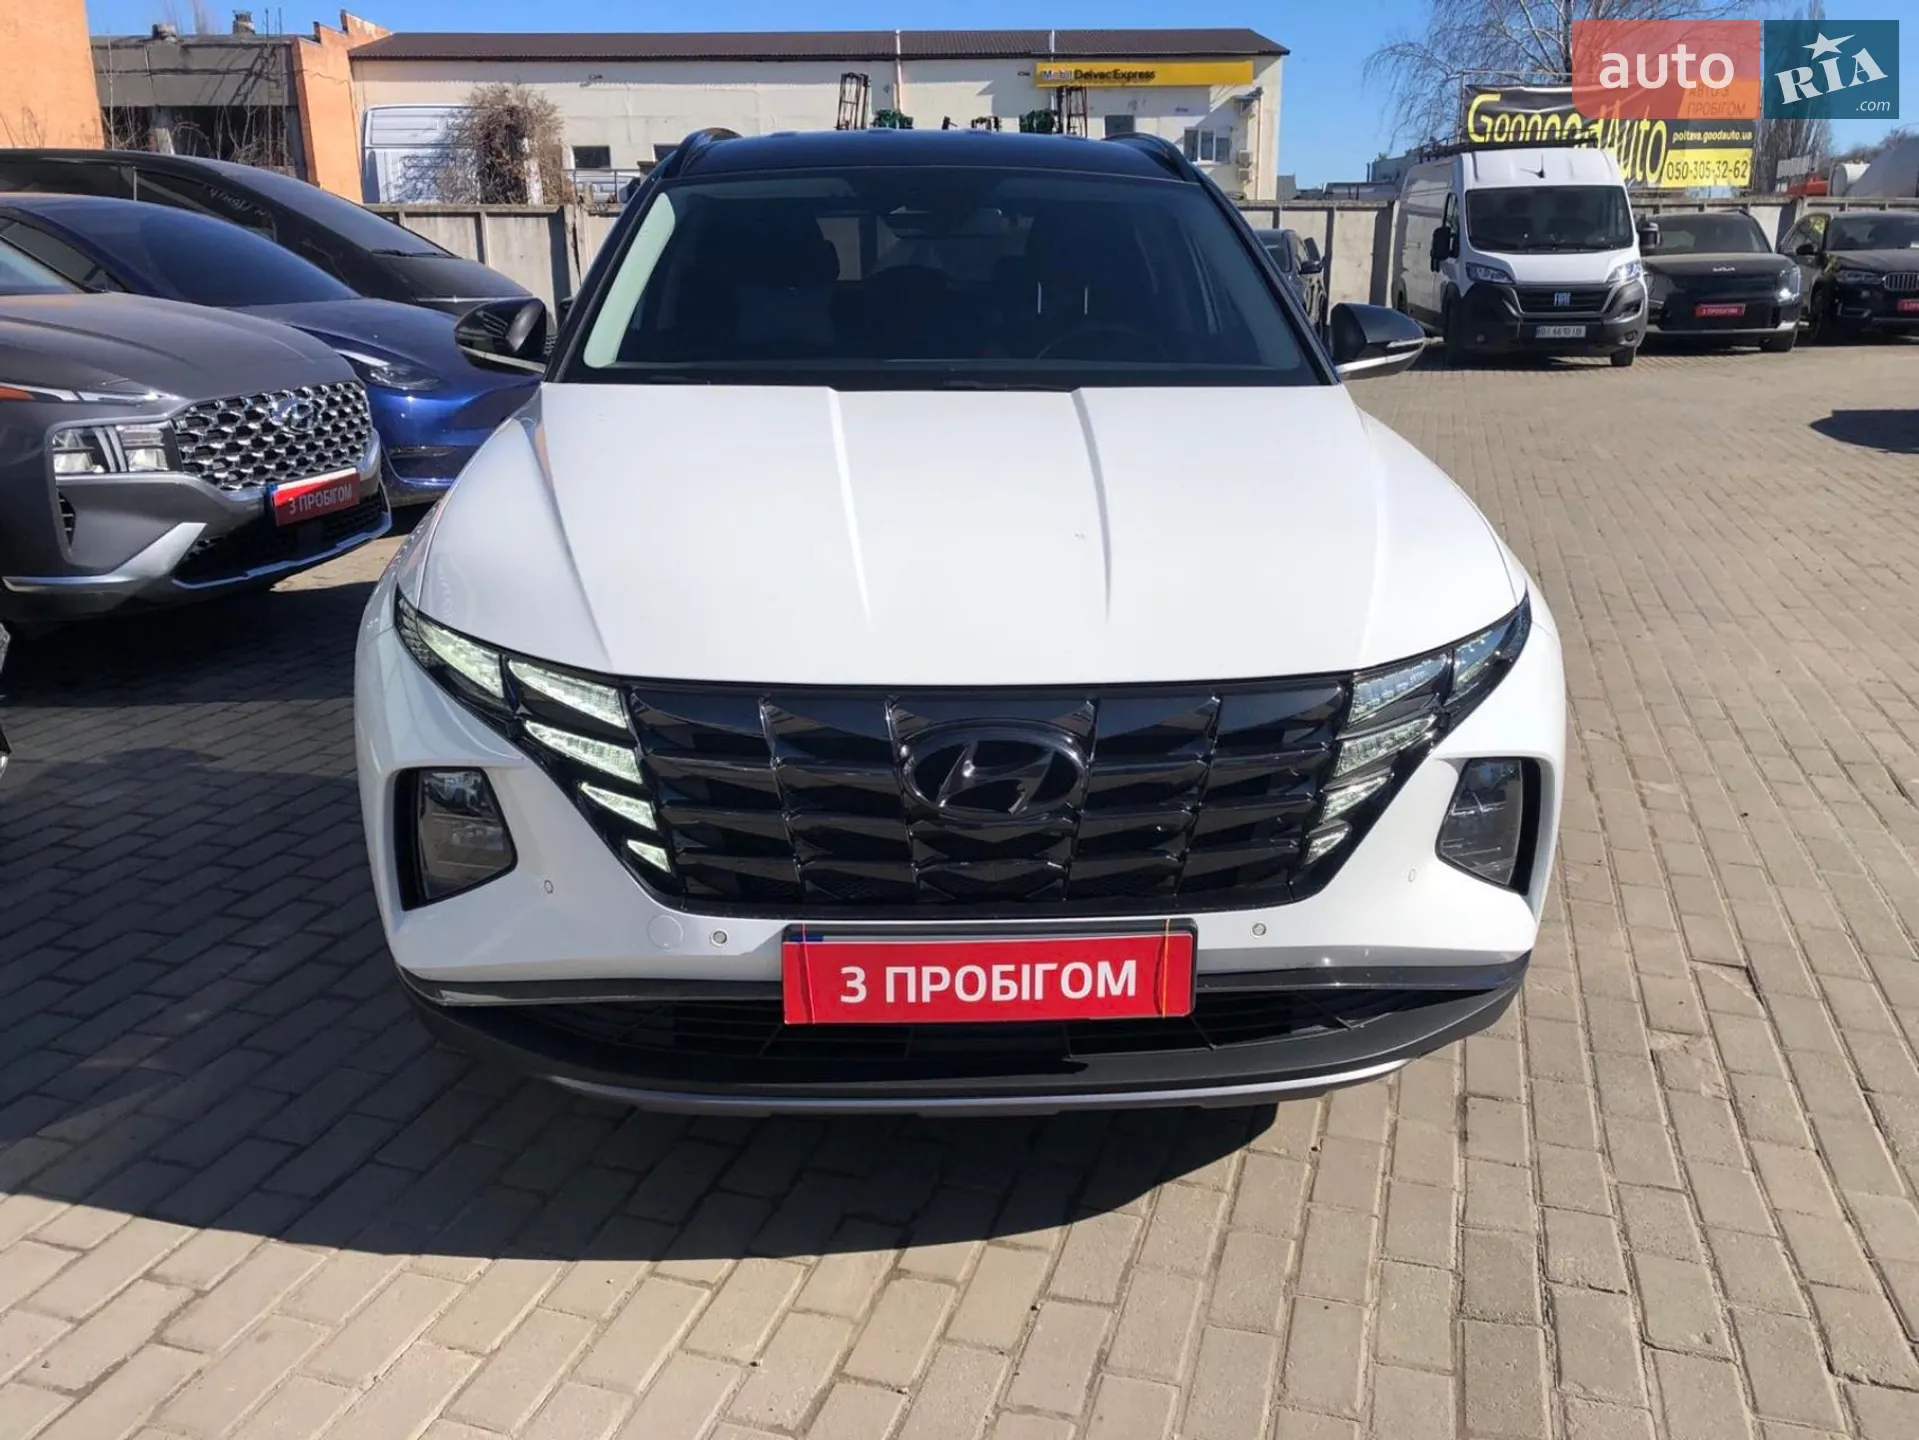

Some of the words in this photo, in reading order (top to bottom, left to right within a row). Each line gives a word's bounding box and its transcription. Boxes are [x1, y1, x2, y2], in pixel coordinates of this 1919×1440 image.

[1043, 68, 1073, 80] Mobil
[1666, 160, 1749, 180] 050-305-32-62
[299, 483, 353, 513] ПРОБІГОМ
[840, 966, 867, 1003] З
[885, 960, 1137, 1003] ПРОБІГОМ
